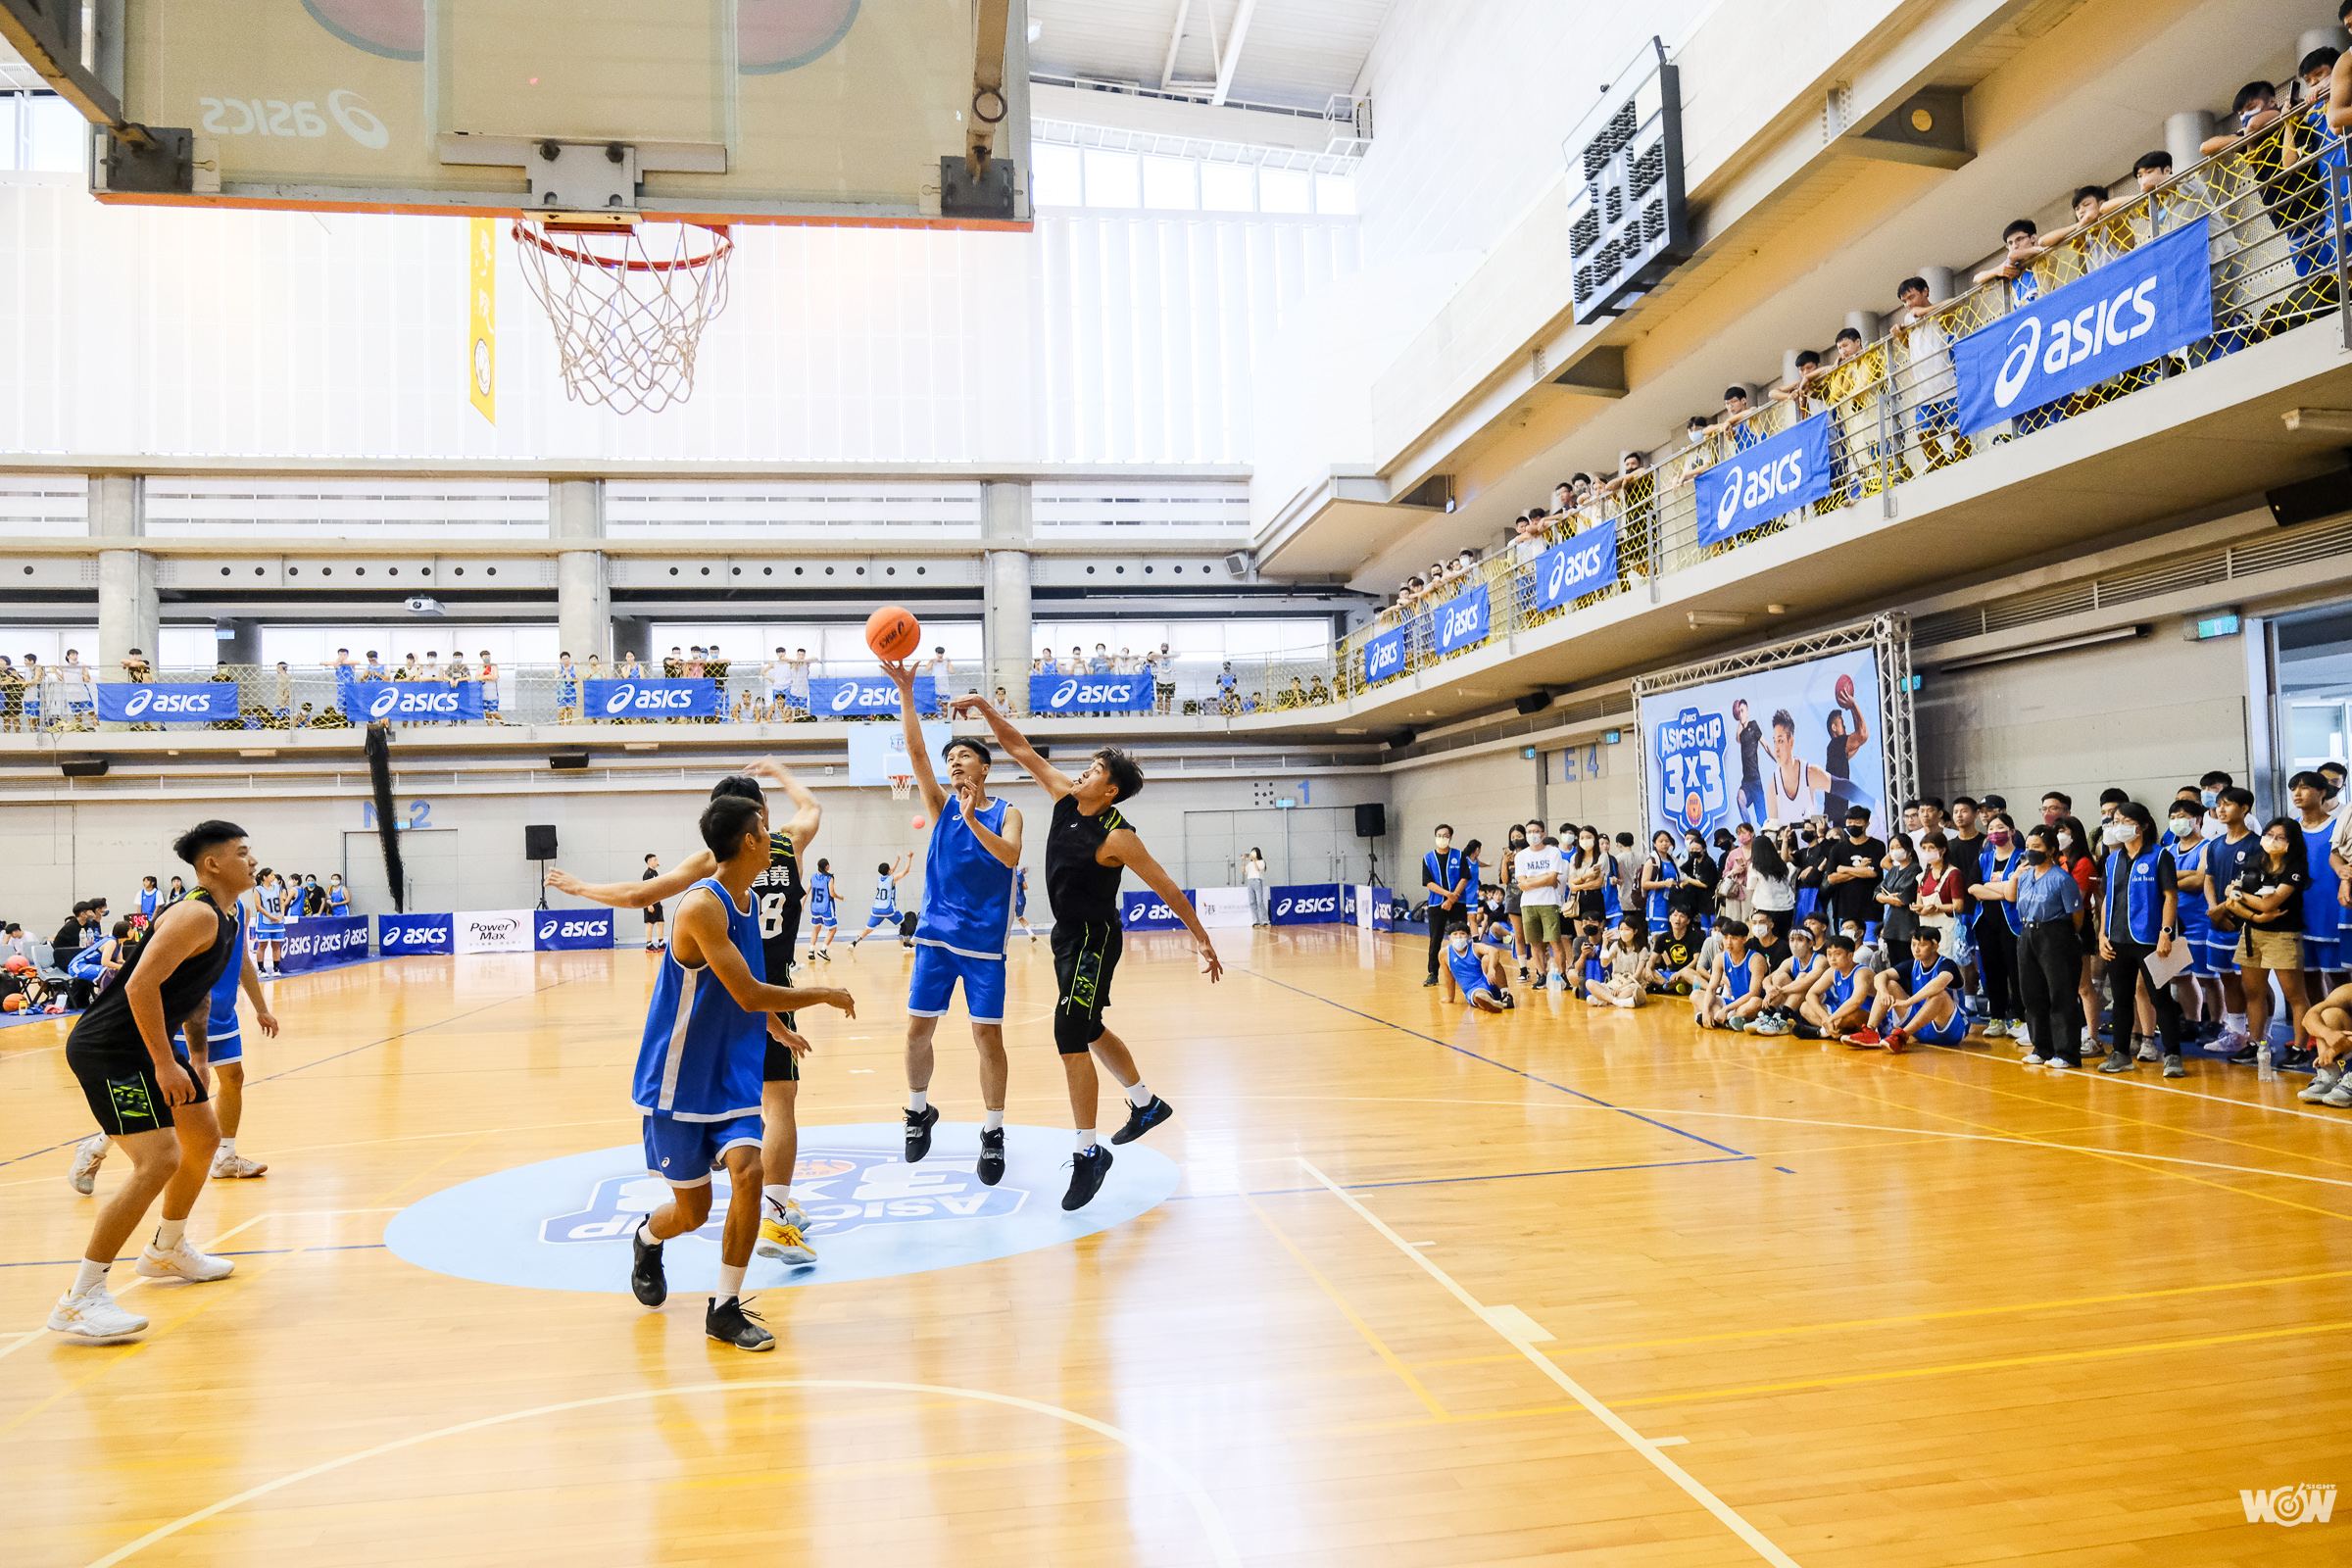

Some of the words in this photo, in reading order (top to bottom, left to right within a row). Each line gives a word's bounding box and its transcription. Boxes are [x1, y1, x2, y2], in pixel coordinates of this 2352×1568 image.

[2043, 275, 2157, 374] asics
[1743, 448, 1802, 510] asics
[1564, 544, 1600, 585] asics
[1454, 604, 1478, 637] asics
[153, 694, 211, 712] asics
[399, 692, 459, 711] asics
[635, 689, 692, 709] asics
[858, 688, 901, 706] asic
[1077, 684, 1130, 703] asics
[1661, 726, 1695, 757] ASICS
[1695, 717, 1722, 748] CUP
[1564, 746, 1576, 781] E
[1588, 743, 1599, 780] 4
[411, 800, 432, 828] 2
[811, 887, 824, 903] 15
[876, 888, 888, 901] 20
[267, 897, 281, 912] 18
[1295, 897, 1336, 913] asics
[403, 927, 448, 944] asics
[470, 922, 511, 932] Power
[480, 932, 506, 941] Max
[561, 921, 608, 937] asics
[289, 934, 311, 956] asics
[319, 933, 341, 953] asics
